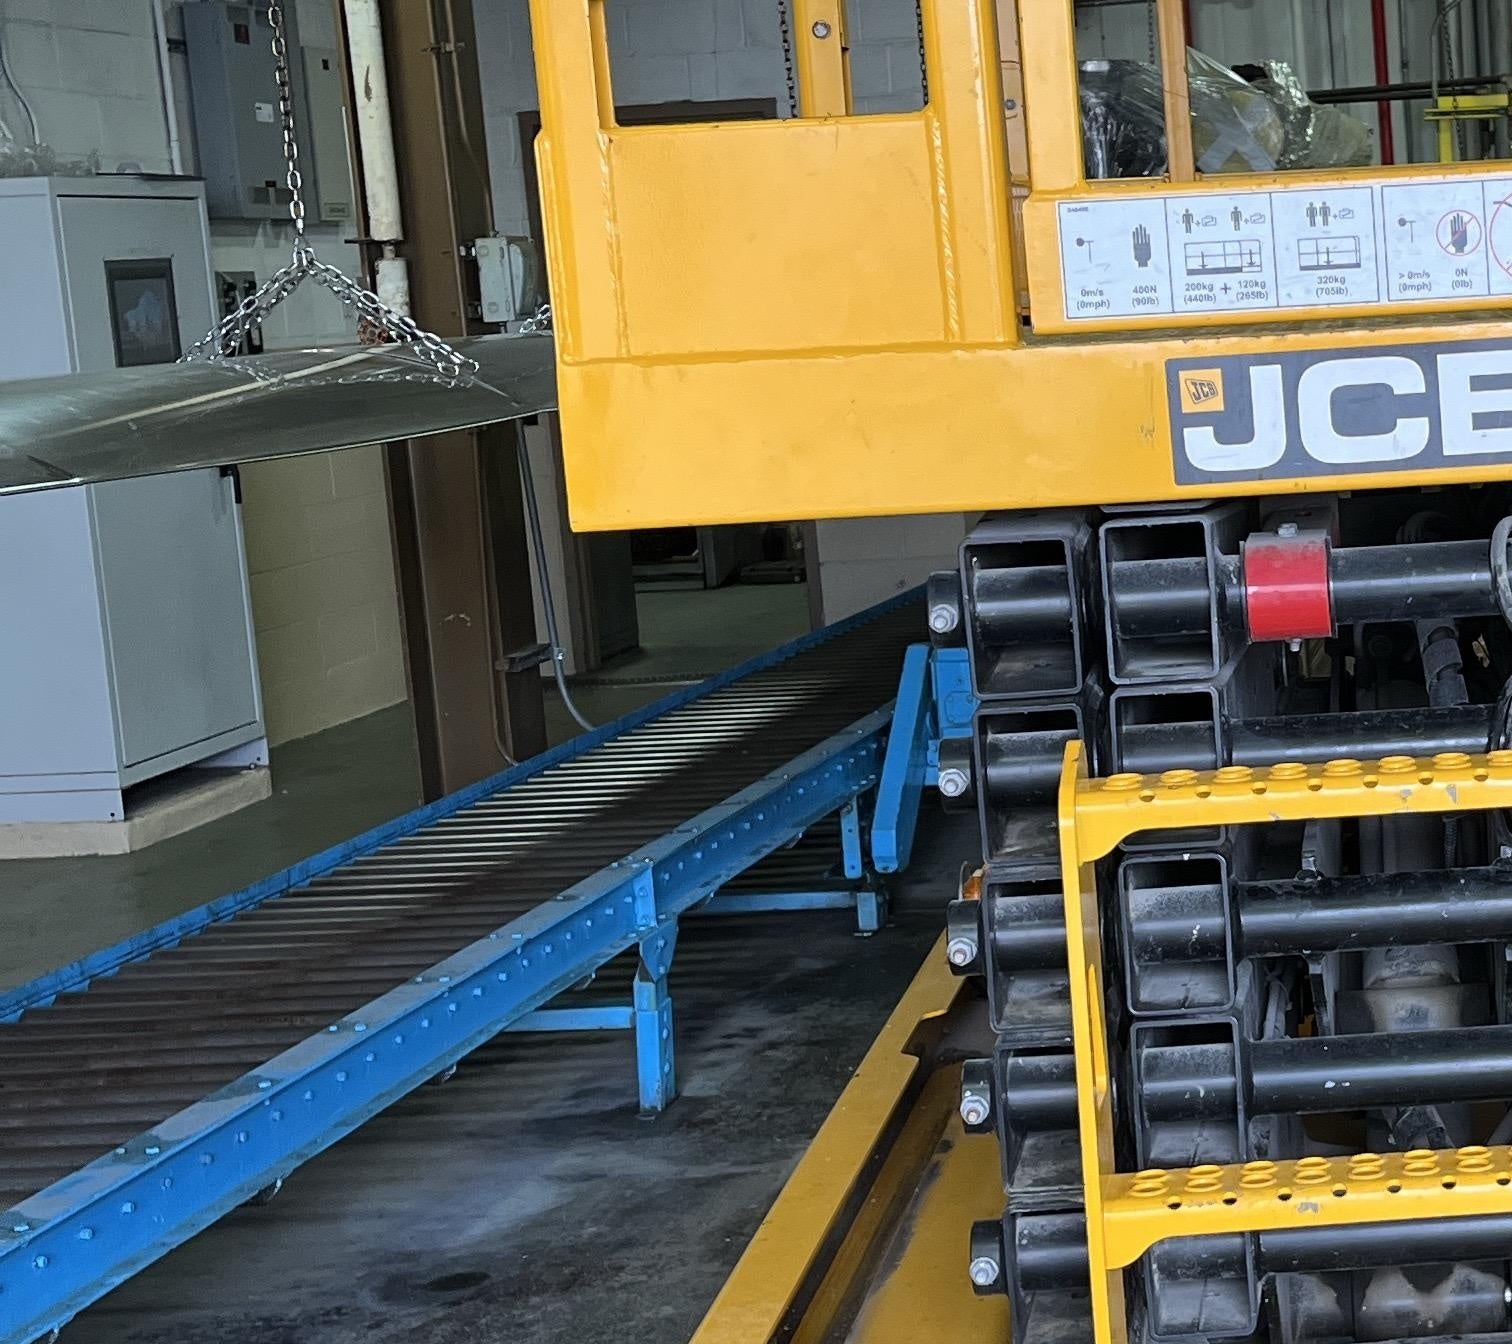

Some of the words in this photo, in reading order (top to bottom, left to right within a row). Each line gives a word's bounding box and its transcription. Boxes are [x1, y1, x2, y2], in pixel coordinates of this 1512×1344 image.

[1455, 267, 1468, 277] 0N
[1184, 282, 1214, 292] 200kg
[1238, 279, 1266, 290] 120kg
[1317, 275, 1346, 285] 320kg
[1451, 278, 1473, 290] (0lb)
[1132, 284, 1157, 294] 400N
[1315, 286, 1349, 298] (705lb)
[1398, 282, 1432, 294] (0mph)
[1131, 296, 1160, 309] (90lb)
[1183, 293, 1217, 305] (440lb)
[1236, 290, 1269, 303] (265lb)
[1076, 299, 1111, 311] (0mph)
[1190, 381, 1216, 402] JCB
